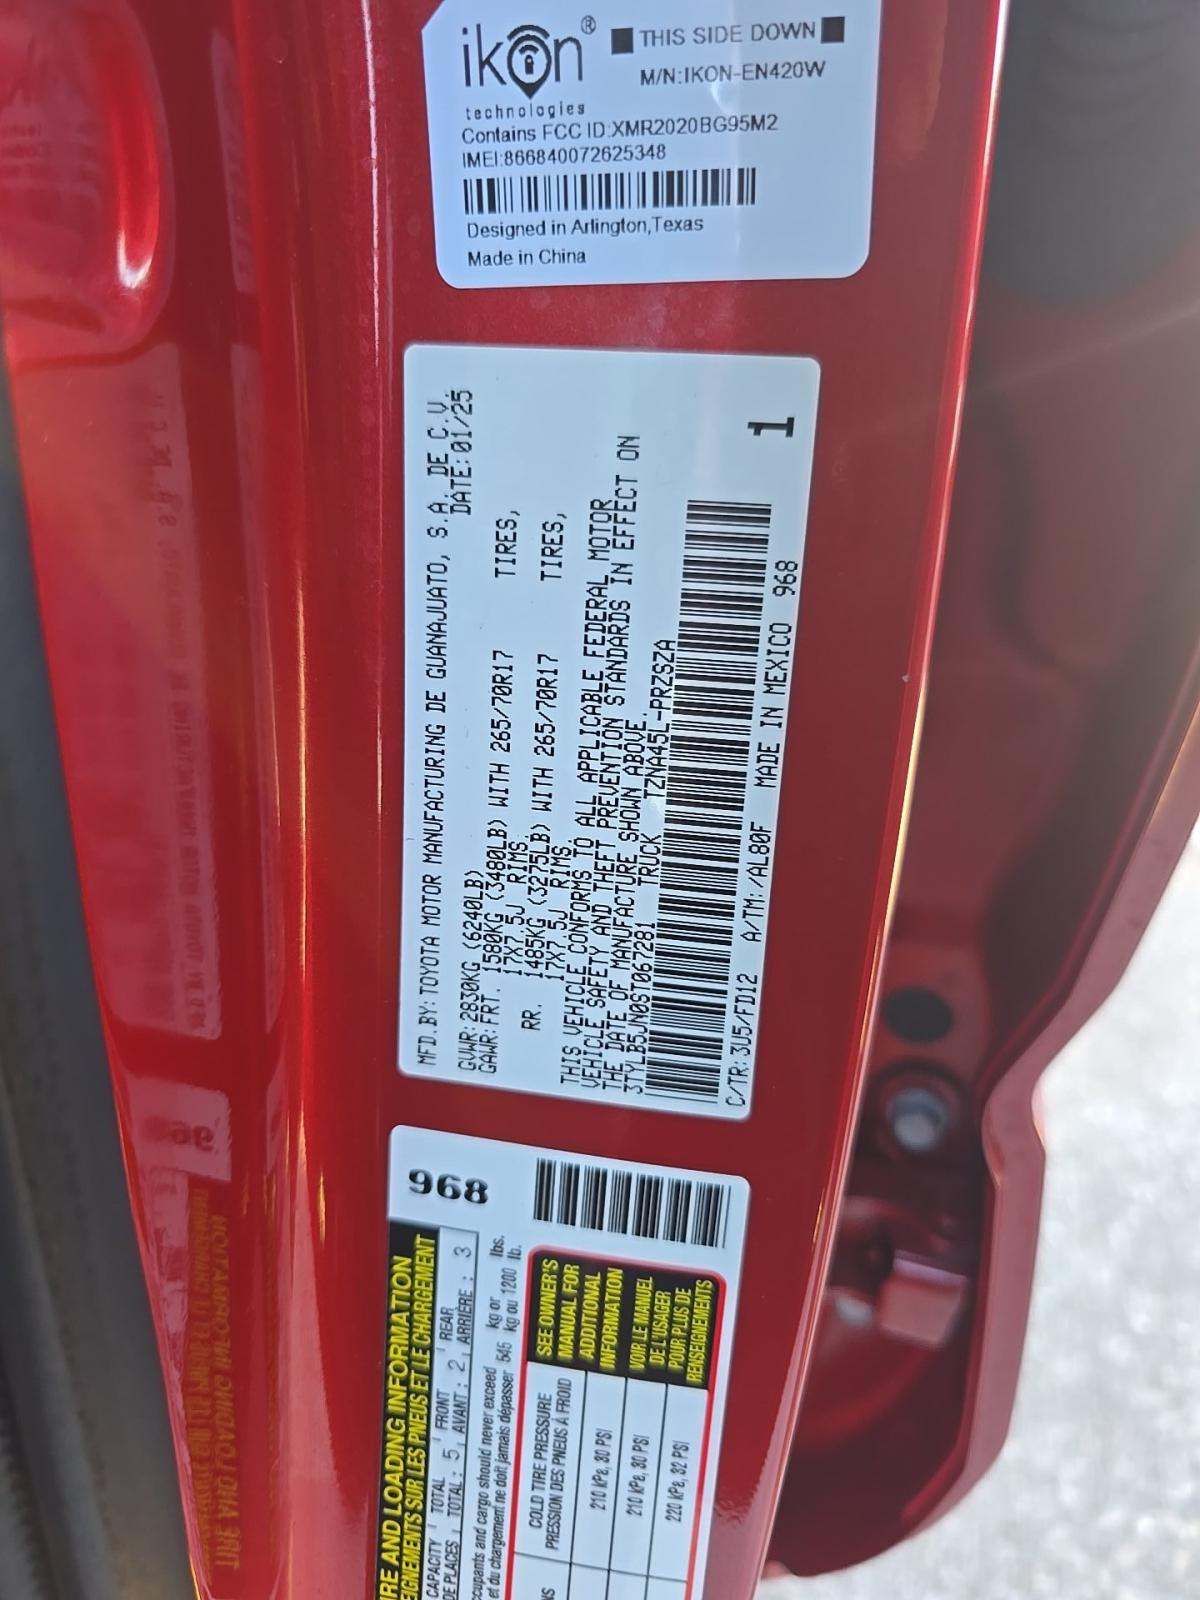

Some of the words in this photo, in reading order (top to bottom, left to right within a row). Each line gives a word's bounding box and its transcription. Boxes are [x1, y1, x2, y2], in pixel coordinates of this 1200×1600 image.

[640, 28, 685, 46] THIS
[693, 25, 742, 45] SIDE
[751, 22, 816, 41] DOWN
[466, 101, 585, 121] technologies
[461, 124, 536, 144] Contains
[543, 123, 582, 140] FCC
[462, 144, 667, 168] IMEI:866840072625348
[467, 220, 547, 240] Designed
[551, 220, 567, 235] in
[468, 252, 514, 267] Made
[518, 250, 534, 266] in
[538, 248, 587, 266] China
[746, 416, 795, 439] 1
[426, 452, 449, 478] DE
[616, 435, 640, 462] ON
[587, 499, 613, 562] MOTOR
[611, 474, 638, 551] EFFECT
[494, 510, 520, 579] TIRES,
[539, 513, 566, 582] TIRES,
[609, 562, 633, 586] IN
[771, 560, 798, 598] 968
[425, 555, 449, 680] GUANAJUATO,
[582, 574, 609, 659] FEDERAL
[603, 599, 631, 707] STANDARDS
[762, 622, 792, 696] MEXICO
[424, 690, 446, 714] DE
[489, 650, 514, 754] 265/70R17
[533, 653, 559, 758] 265/70R17
[759, 706, 784, 729] IN
[576, 669, 604, 784] APPLICABLE
[621, 713, 647, 777] ABOVE.
[487, 763, 510, 808] WITH
[595, 717, 624, 830] PREVENTION
[753, 742, 780, 789] MADE
[421, 724, 445, 865] MANUFACTURING
[530, 767, 554, 813] WITH
[573, 795, 597, 828] ALL
[617, 787, 642, 843] SHOWN
[484, 819, 508, 901] (3480LB)
[506, 835, 529, 885] RIMS.
[526, 824, 551, 906] (3275LB)
[548, 840, 572, 890] RIMS.
[570, 837, 595, 859] TO
[592, 839, 616, 893] THEFT
[636, 833, 662, 887] TRUCK
[420, 874, 442, 927] MOTOR
[461, 870, 484, 951] (6240LB)
[566, 869, 592, 955] CONFORMS
[589, 904, 612, 937] AND
[609, 852, 638, 971] MANUFACTURE
[481, 912, 504, 974] 1580KG
[523, 917, 547, 979] 1485KG
[585, 945, 610, 1009] SAFETY
[607, 979, 629, 1002] OF
[520, 1004, 542, 1032] RR.
[562, 964, 587, 1036] VEHICLE
[622, 923, 656, 1095] 3TYLB5JN0ST067281
[604, 1010, 627, 1053] DATE
[559, 1045, 582, 1085] THIS
[580, 1017, 605, 1089] VEHICLE
[601, 1061, 624, 1091] THE
[408, 1168, 488, 1205] 968
[452, 1246, 471, 1259] 3
[412, 1234, 435, 1346] CHARGEMENT
[500, 1268, 517, 1295] 1200
[538, 1259, 559, 1327] OWNER'S
[562, 1264, 580, 1294] FOR
[674, 1287, 691, 1304] DE
[489, 1296, 500, 1311] or
[507, 1300, 518, 1314] ou
[579, 1271, 601, 1359] ADDITIONAL
[599, 1268, 623, 1369] INFORMATION
[632, 1275, 653, 1325] MANUEL
[387, 1255, 412, 1414] INFORMATION
[439, 1307, 454, 1342] REAR
[485, 1314, 502, 1330] kg
[503, 1316, 520, 1333] kg
[557, 1297, 577, 1359] MANUAL
[631, 1327, 648, 1341] LE
[671, 1306, 689, 1336] PLUS
[685, 1279, 714, 1383] RENSEIGNEMENTS
[411, 1348, 430, 1367] LE
[536, 1327, 554, 1357] SEE
[628, 1342, 646, 1370] VOIR
[648, 1348, 666, 1366] DE
[667, 1338, 686, 1369] POUR
[410, 1370, 429, 1391] ET
[447, 1359, 465, 1372] 2
[481, 1366, 496, 1410] exceed
[555, 1378, 572, 1415] FROID
[407, 1393, 428, 1444] PNEUS
[434, 1389, 450, 1431] FRONT
[480, 1413, 493, 1446] never
[533, 1393, 552, 1461] PRESSURE
[442, 1448, 460, 1461] 5
[495, 1426, 512, 1465] jamais
[551, 1427, 569, 1467] PNEUS
[595, 1429, 612, 1448] PSI
[632, 1435, 650, 1454] PSI
[671, 1440, 689, 1459] PSI
[383, 1417, 405, 1516] LOADING
[406, 1447, 425, 1475] LES
[476, 1449, 491, 1490] should
[531, 1464, 546, 1492] TIRE
[549, 1469, 565, 1492] DES
[670, 1460, 687, 1475] 32
[404, 1479, 424, 1510] SUR
[476, 1492, 491, 1526] cargo
[528, 1495, 544, 1529] COLD
[381, 1519, 401, 1566] AND
[472, 1527, 486, 1550] and
[488, 1505, 507, 1571] chargement
[545, 1494, 563, 1551] PRESSION
[426, 1539, 442, 1599] CAPACITY
[444, 1540, 459, 1585] PLACES
[487, 1572, 500, 1586] du
[486, 1587, 499, 1599] et
